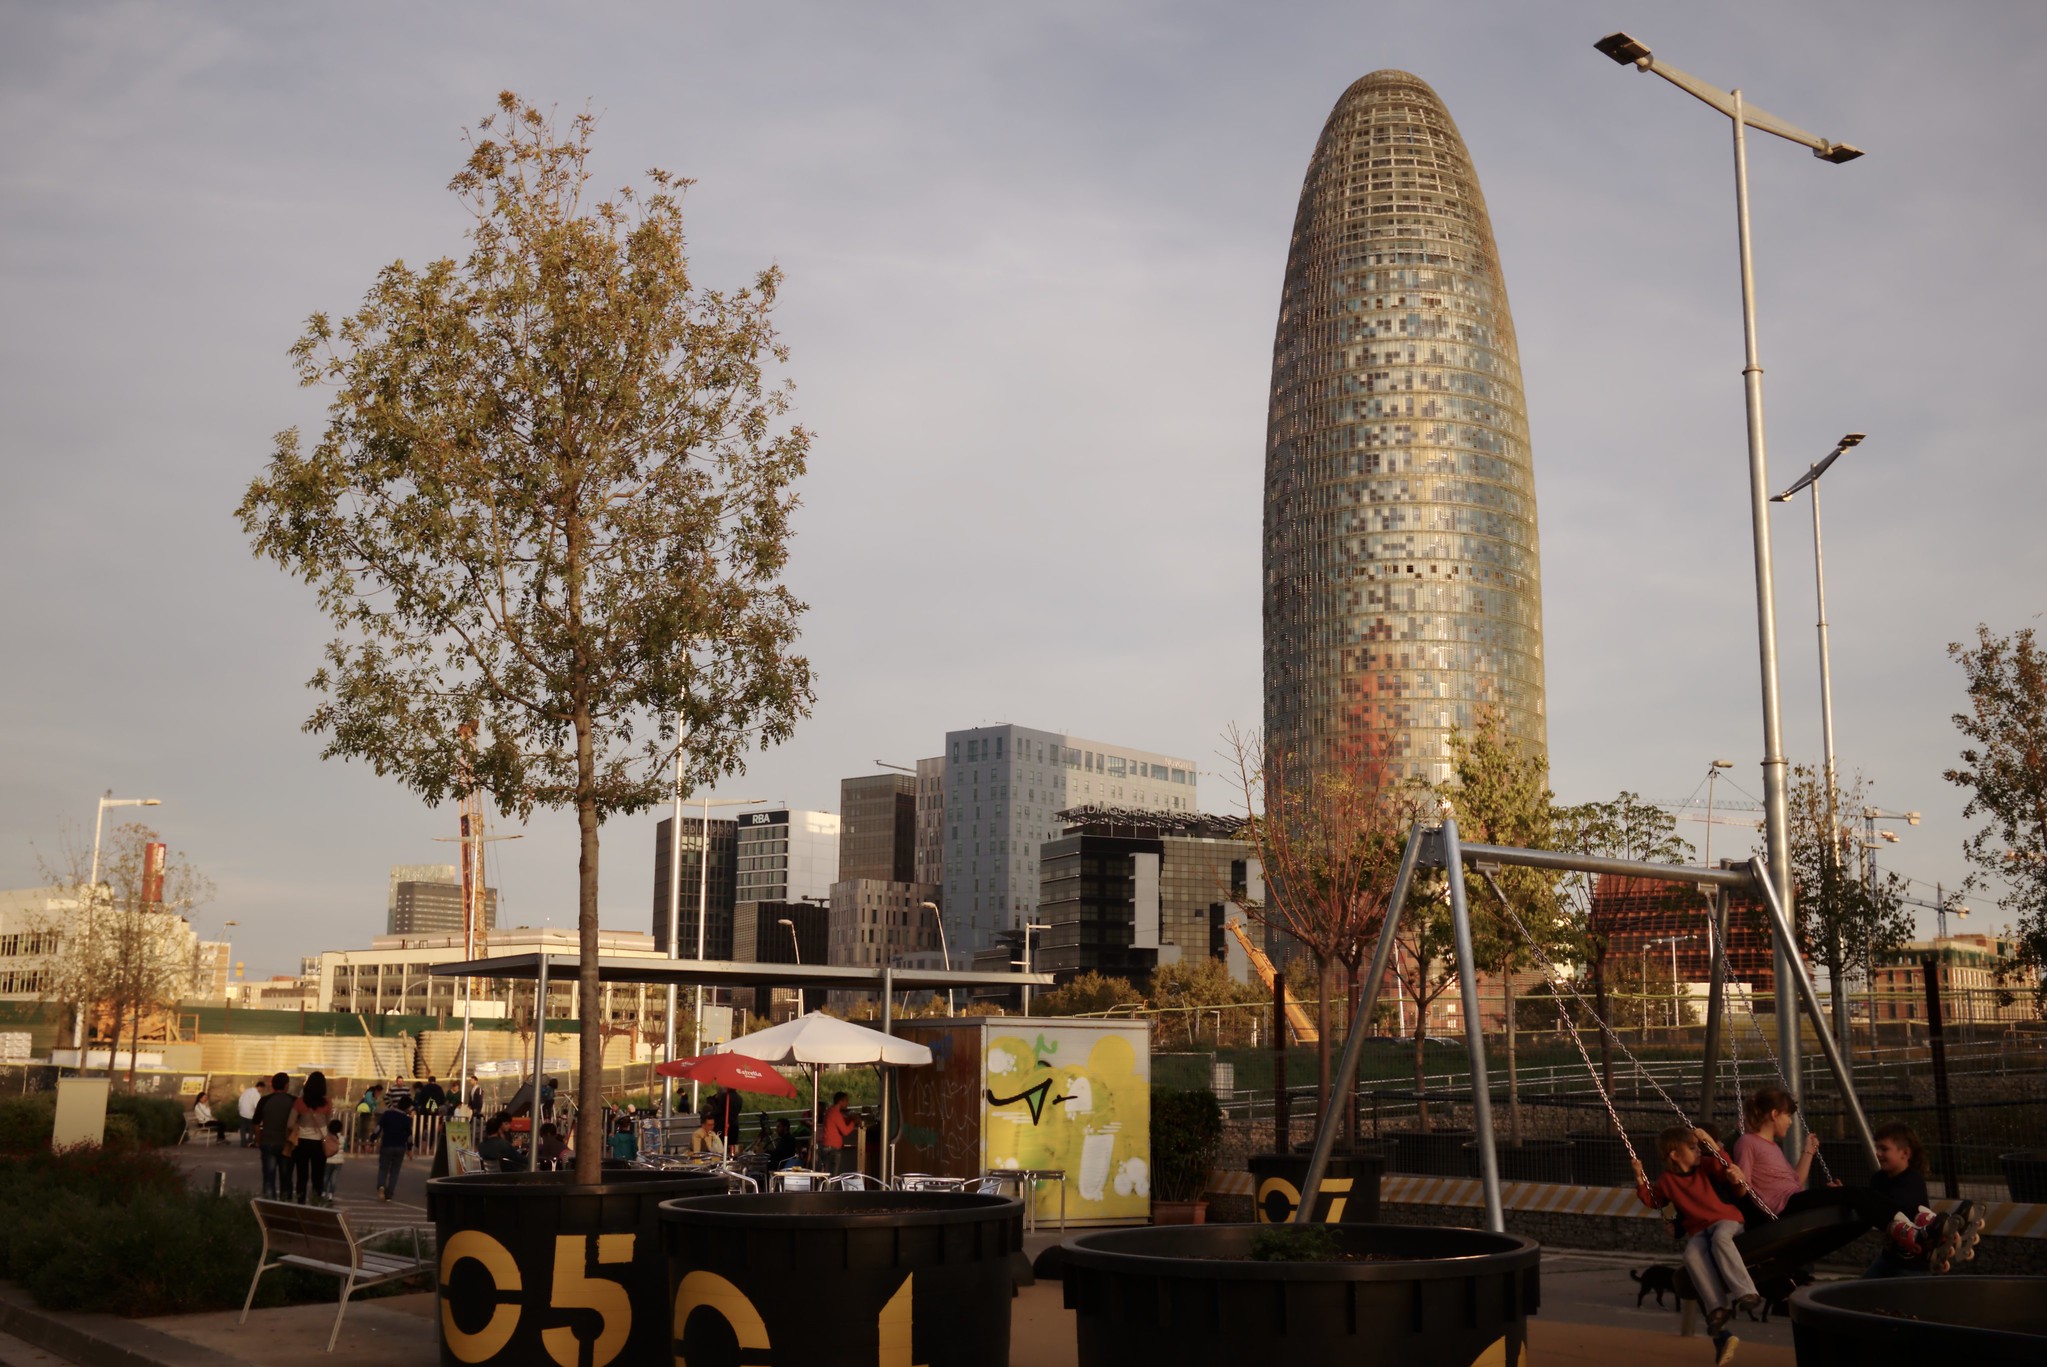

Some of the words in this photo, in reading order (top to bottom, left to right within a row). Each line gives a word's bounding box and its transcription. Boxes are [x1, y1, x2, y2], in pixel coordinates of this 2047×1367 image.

[1069, 807, 1085, 817] HOTEL
[1087, 804, 1153, 818] DIAGONAL
[752, 814, 770, 824] RBA
